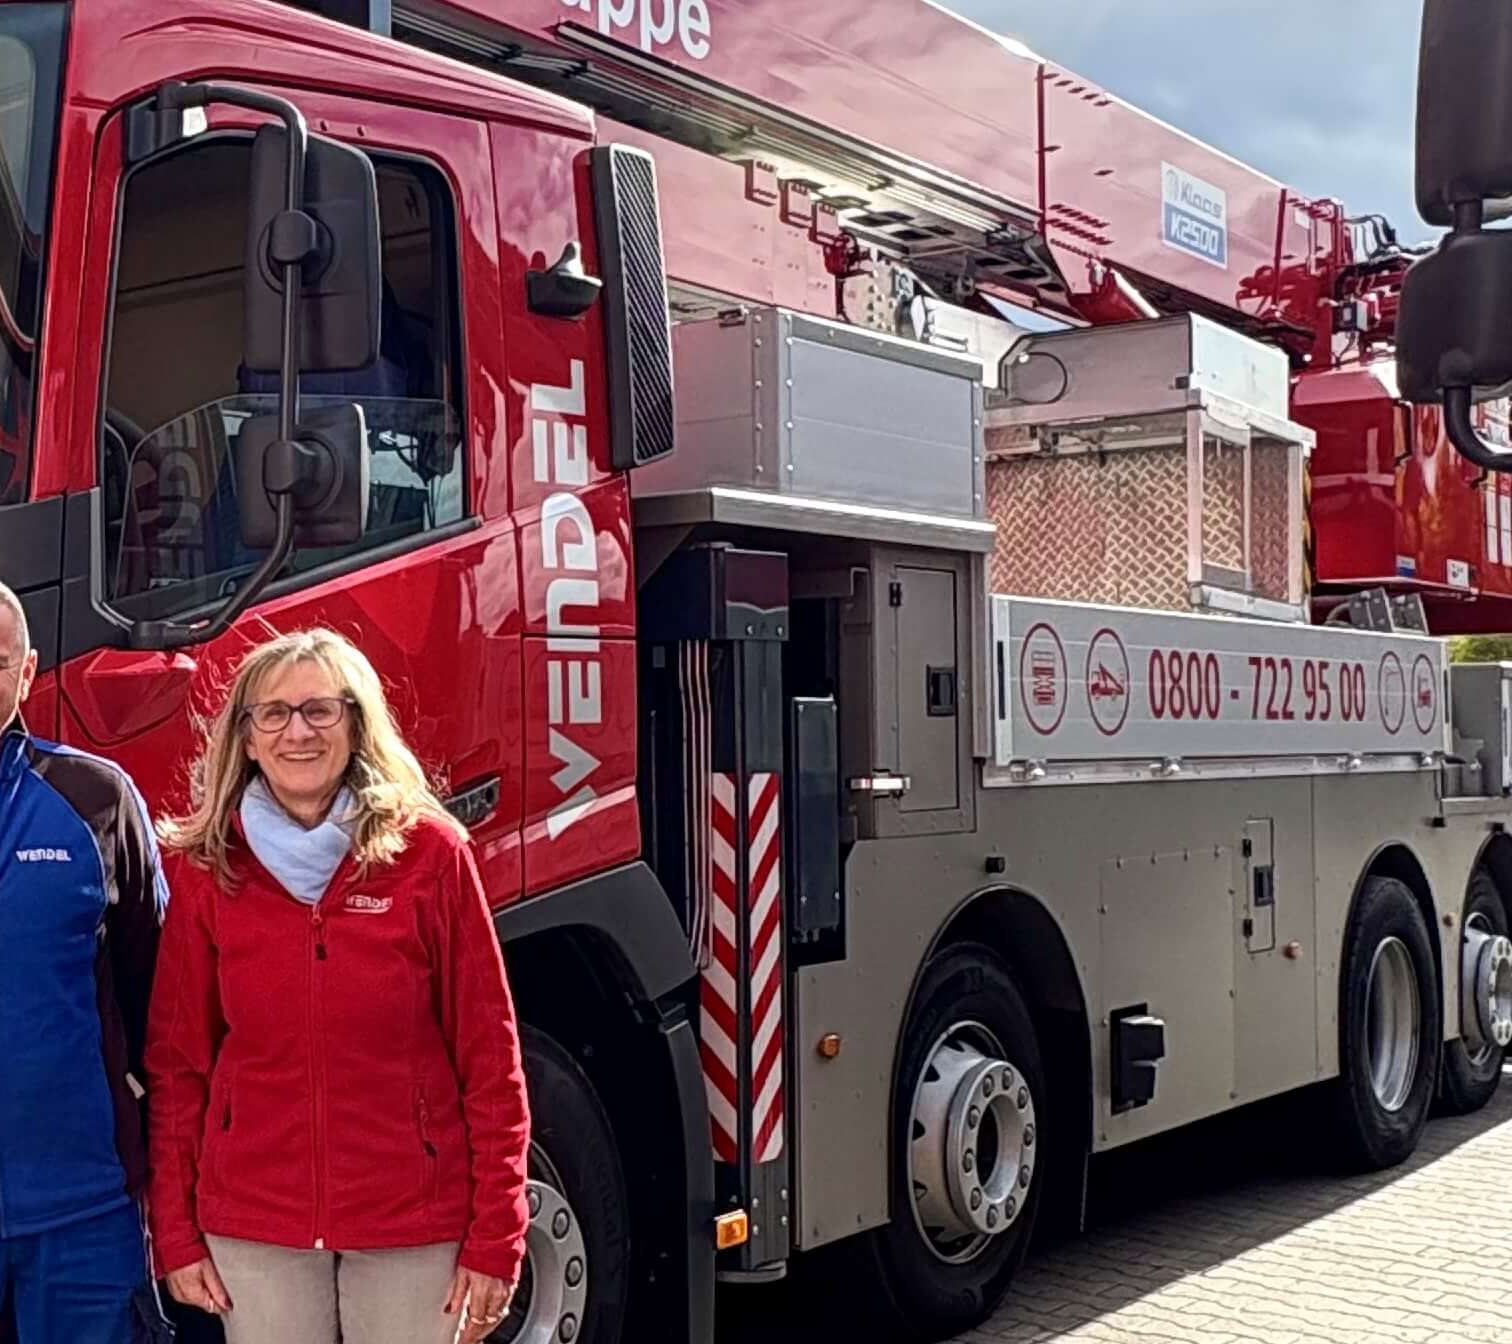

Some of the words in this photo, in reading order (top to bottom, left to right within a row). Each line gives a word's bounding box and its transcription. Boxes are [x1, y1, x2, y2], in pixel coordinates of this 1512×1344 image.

[531, 358, 602, 841] WENDEL
[1148, 649, 1220, 720] 0800
[1249, 656, 1295, 720] 722
[1304, 660, 1331, 721] 95
[1339, 663, 1366, 722] 00
[16, 848, 72, 862] WENDEL
